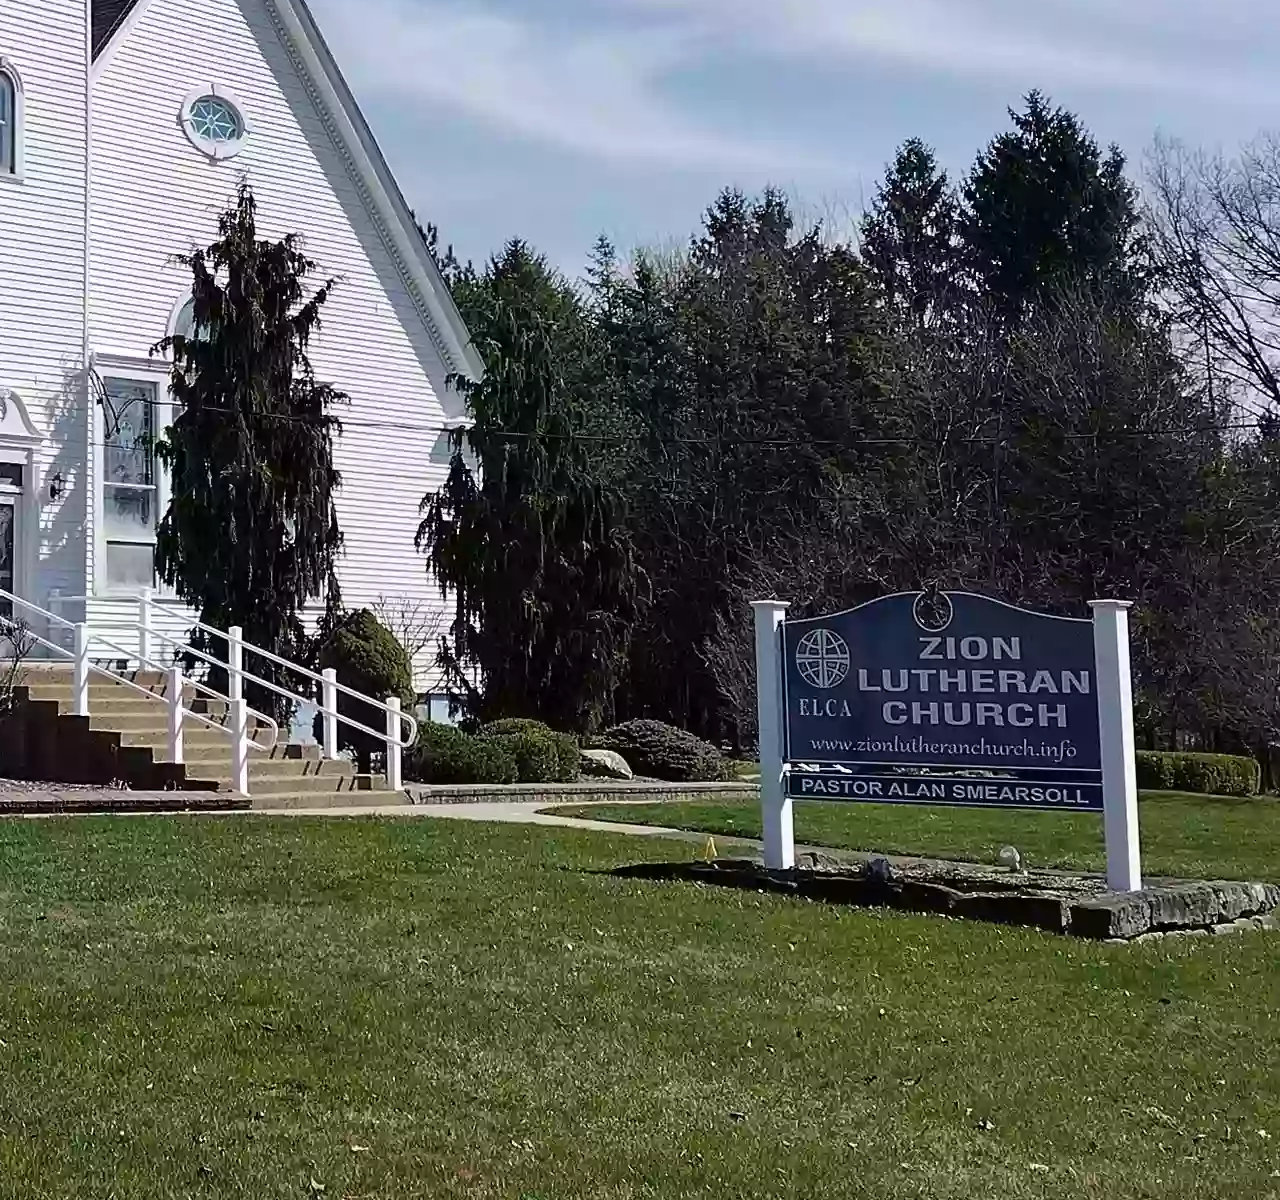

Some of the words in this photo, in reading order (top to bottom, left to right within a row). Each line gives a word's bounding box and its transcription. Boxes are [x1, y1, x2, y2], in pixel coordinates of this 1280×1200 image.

[918, 636, 1021, 660] ZION
[858, 668, 1090, 694] LUTHERAN
[799, 698, 852, 717] ELCA
[882, 700, 1068, 728] CHURCH
[809, 734, 1077, 763] www.zionlutheranchurch.info
[801, 778, 883, 796] PASTOR
[888, 782, 945, 799] ALAN
[952, 784, 1089, 804] SMEARSOLL
